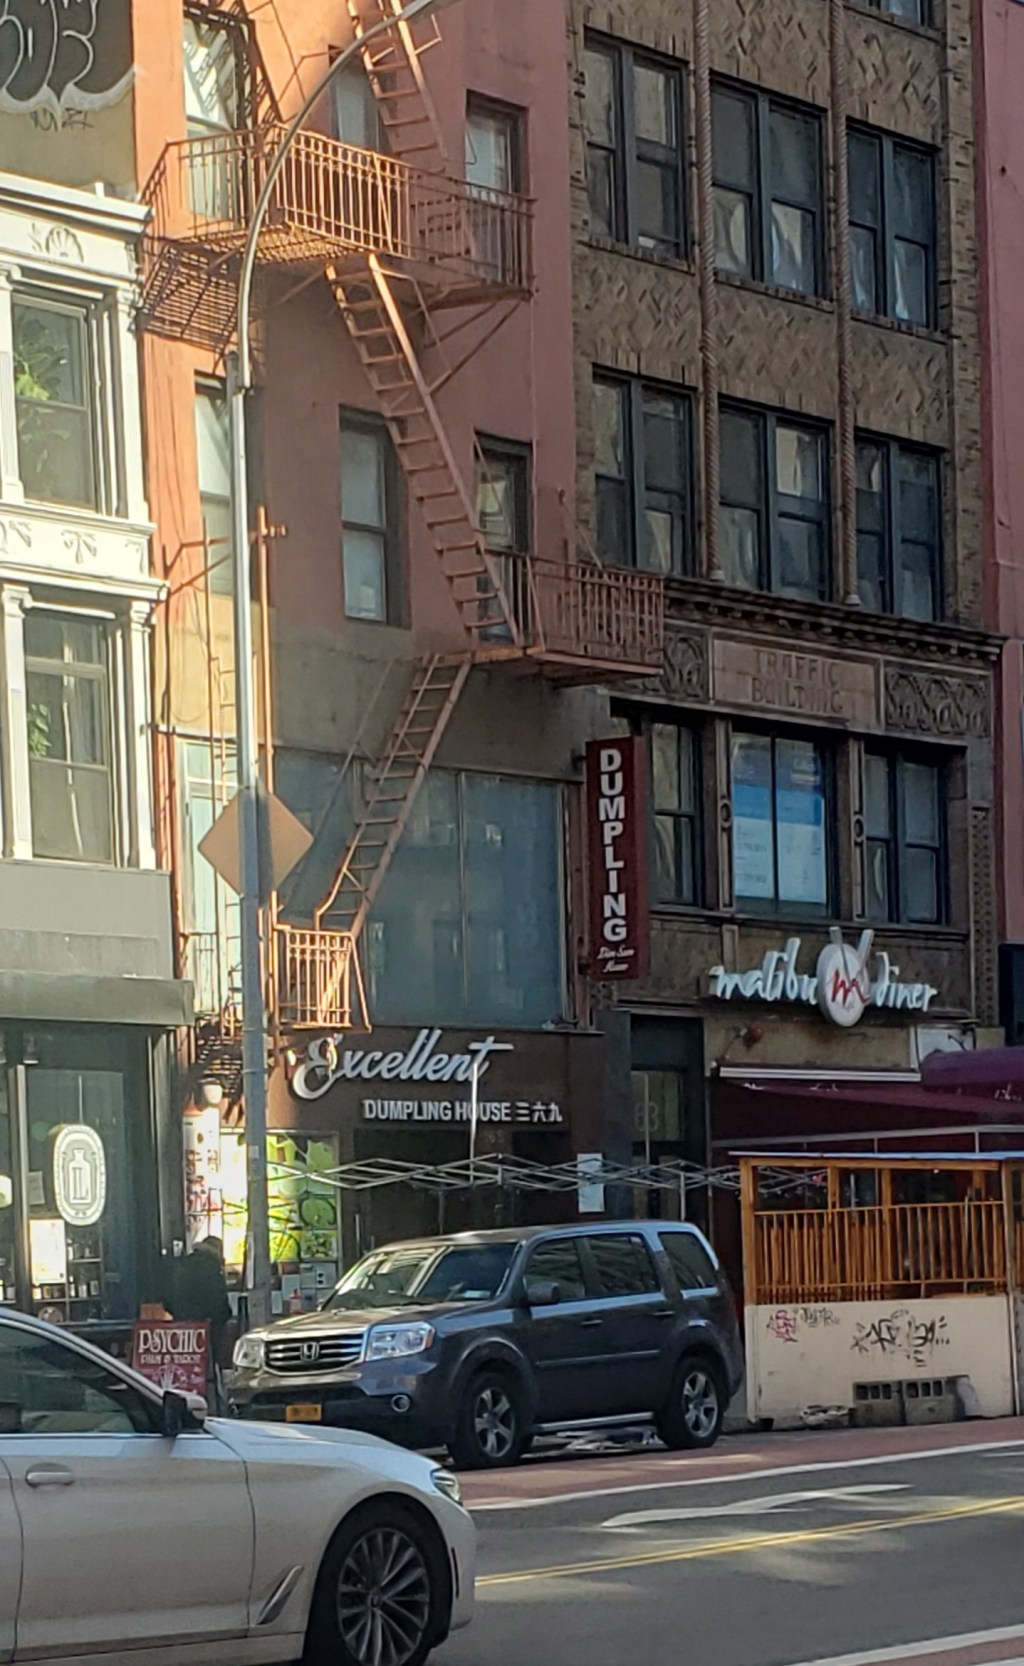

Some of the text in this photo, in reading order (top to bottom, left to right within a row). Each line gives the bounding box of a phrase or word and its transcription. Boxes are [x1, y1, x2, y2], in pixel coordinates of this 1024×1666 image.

[754, 649, 839, 687] TRAFFIC
[752, 677, 843, 714] BUILDING
[599, 748, 628, 942] DUMPLING
[709, 937, 818, 1006] malibu
[872, 951, 938, 1012] diner
[292, 1028, 515, 1099] Excellent
[363, 1099, 512, 1123] DUMPLING HOUSE
[515, 1101, 563, 1123] 三六九
[138, 1328, 206, 1353] PSYCHIC
